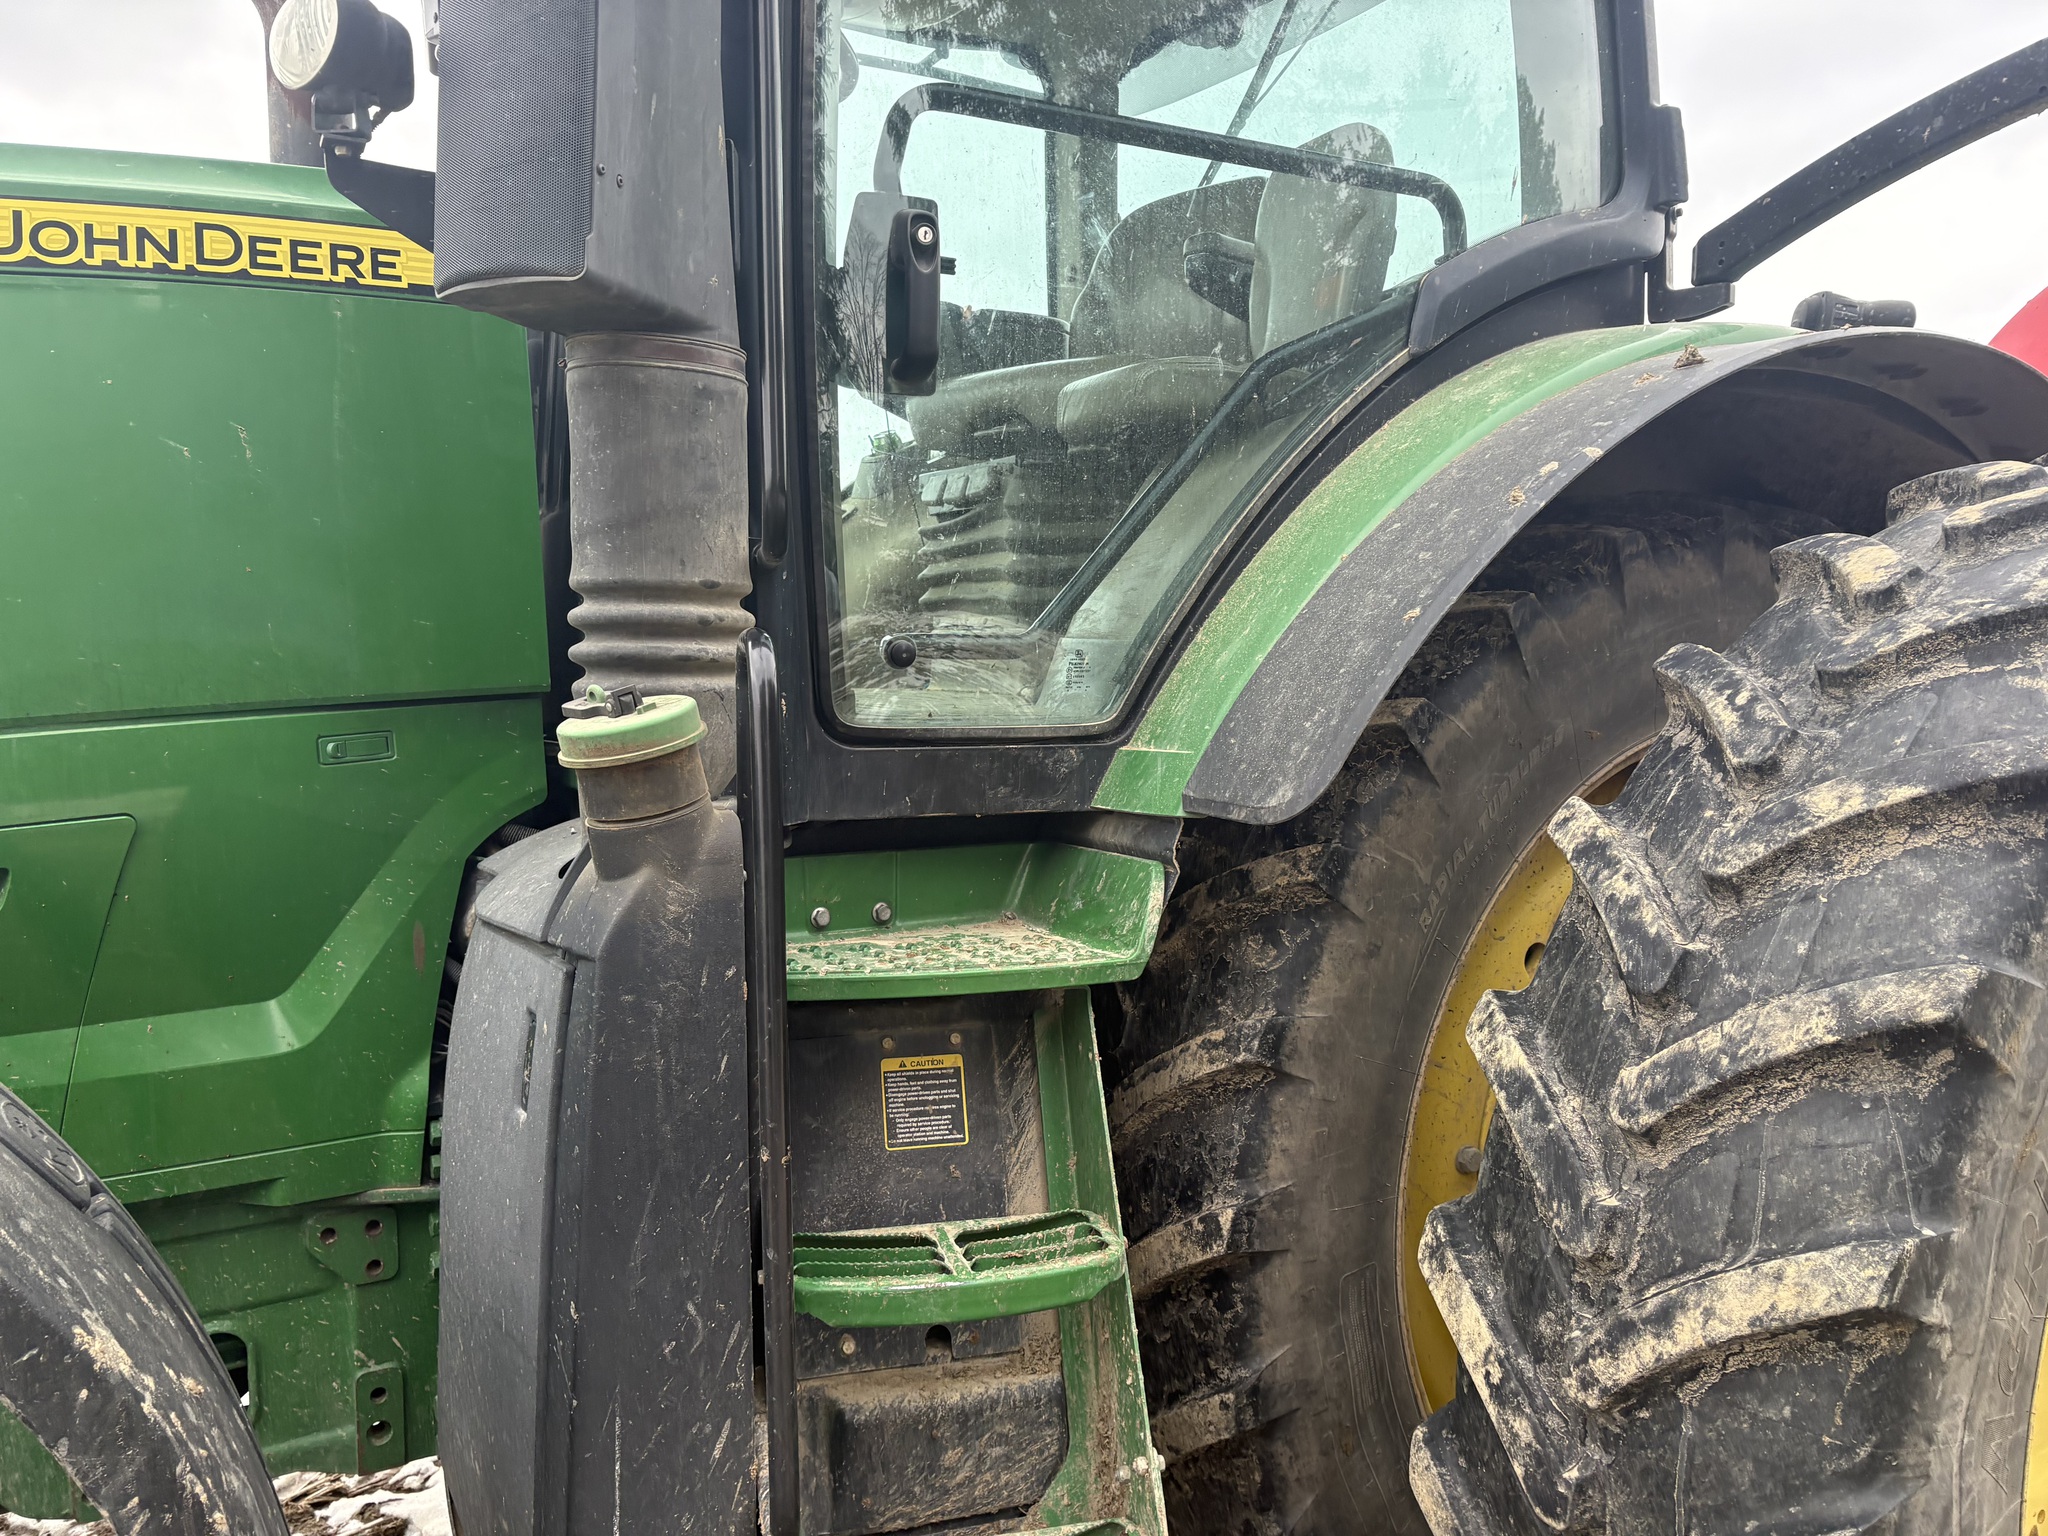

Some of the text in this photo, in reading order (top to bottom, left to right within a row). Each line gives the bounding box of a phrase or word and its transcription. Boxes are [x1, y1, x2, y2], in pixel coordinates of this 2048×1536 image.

[0, 209, 403, 283] JOHN DEERE
[1419, 837, 1474, 933] RADIAL
[910, 1059, 944, 1068] CAUTION
